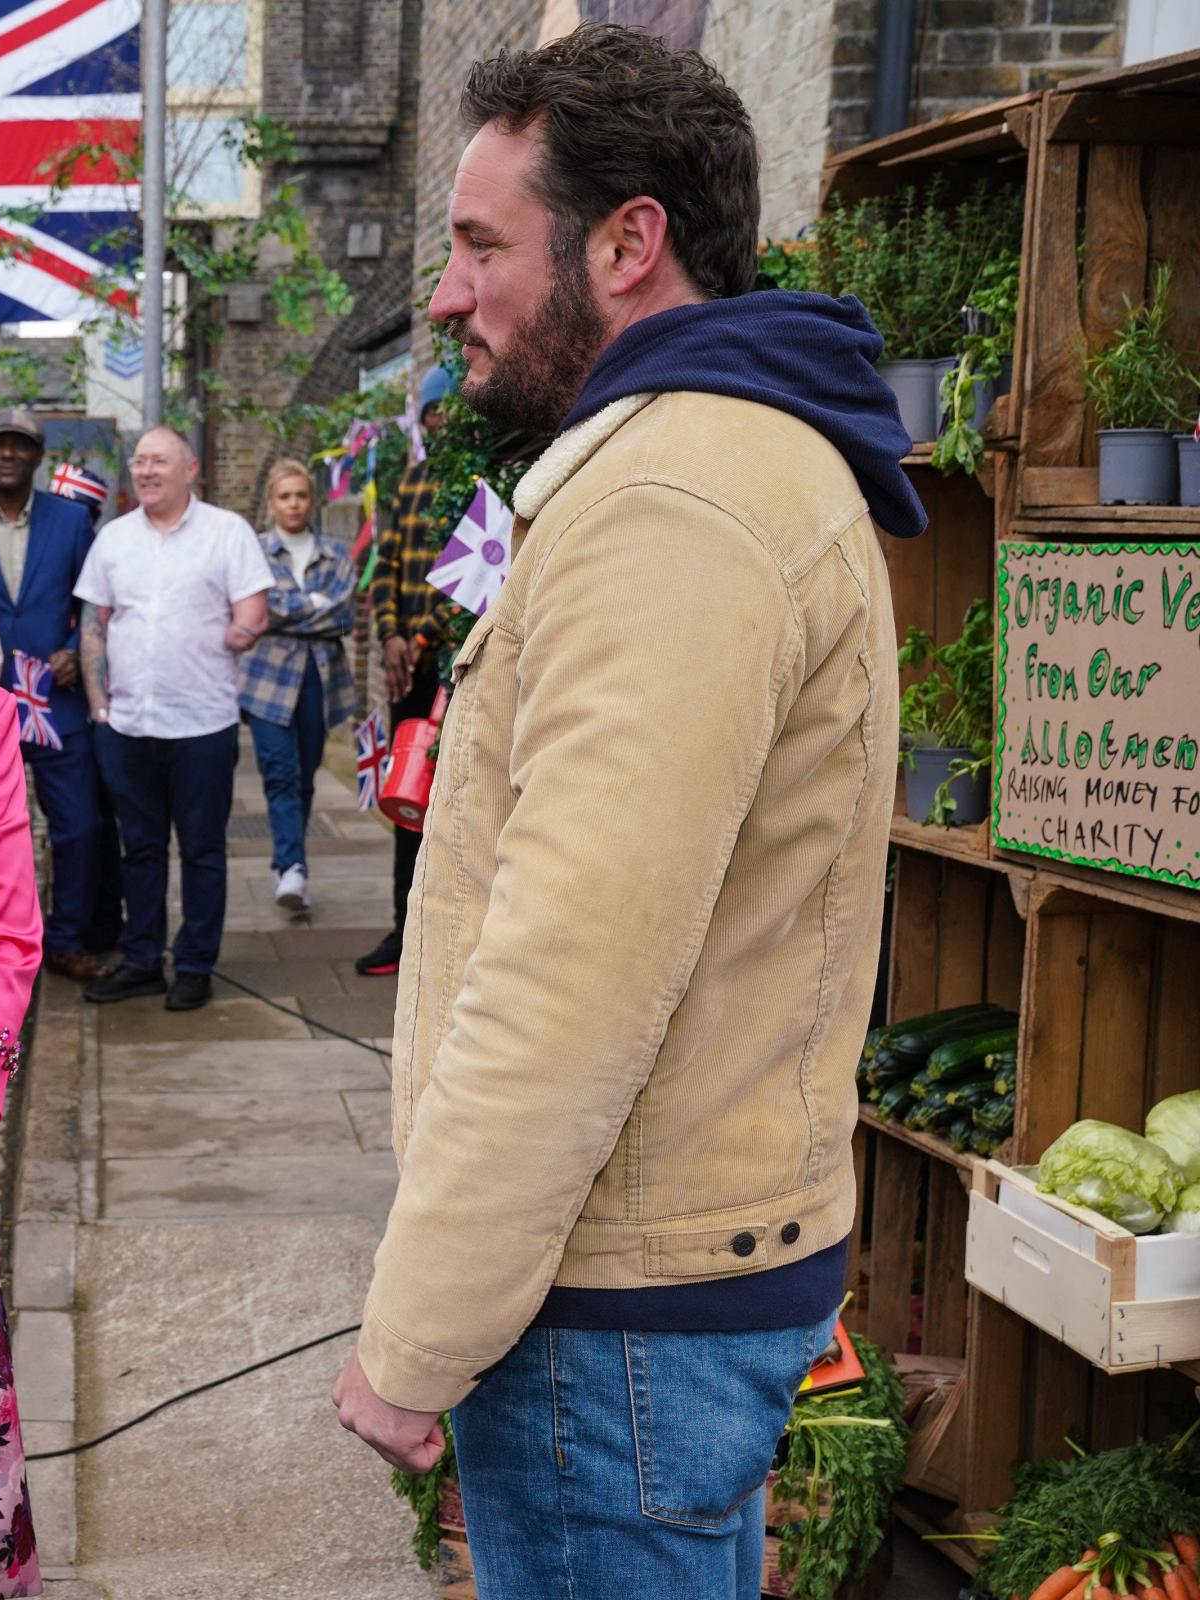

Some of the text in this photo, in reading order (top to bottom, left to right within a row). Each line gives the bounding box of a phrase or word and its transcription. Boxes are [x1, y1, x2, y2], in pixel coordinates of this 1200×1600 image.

[1015, 565, 1200, 648] Organic Ve
[1088, 648, 1162, 700] Our
[1020, 715, 1200, 771] Allotmen
[1007, 767, 1200, 815] RAISING MONEY FO
